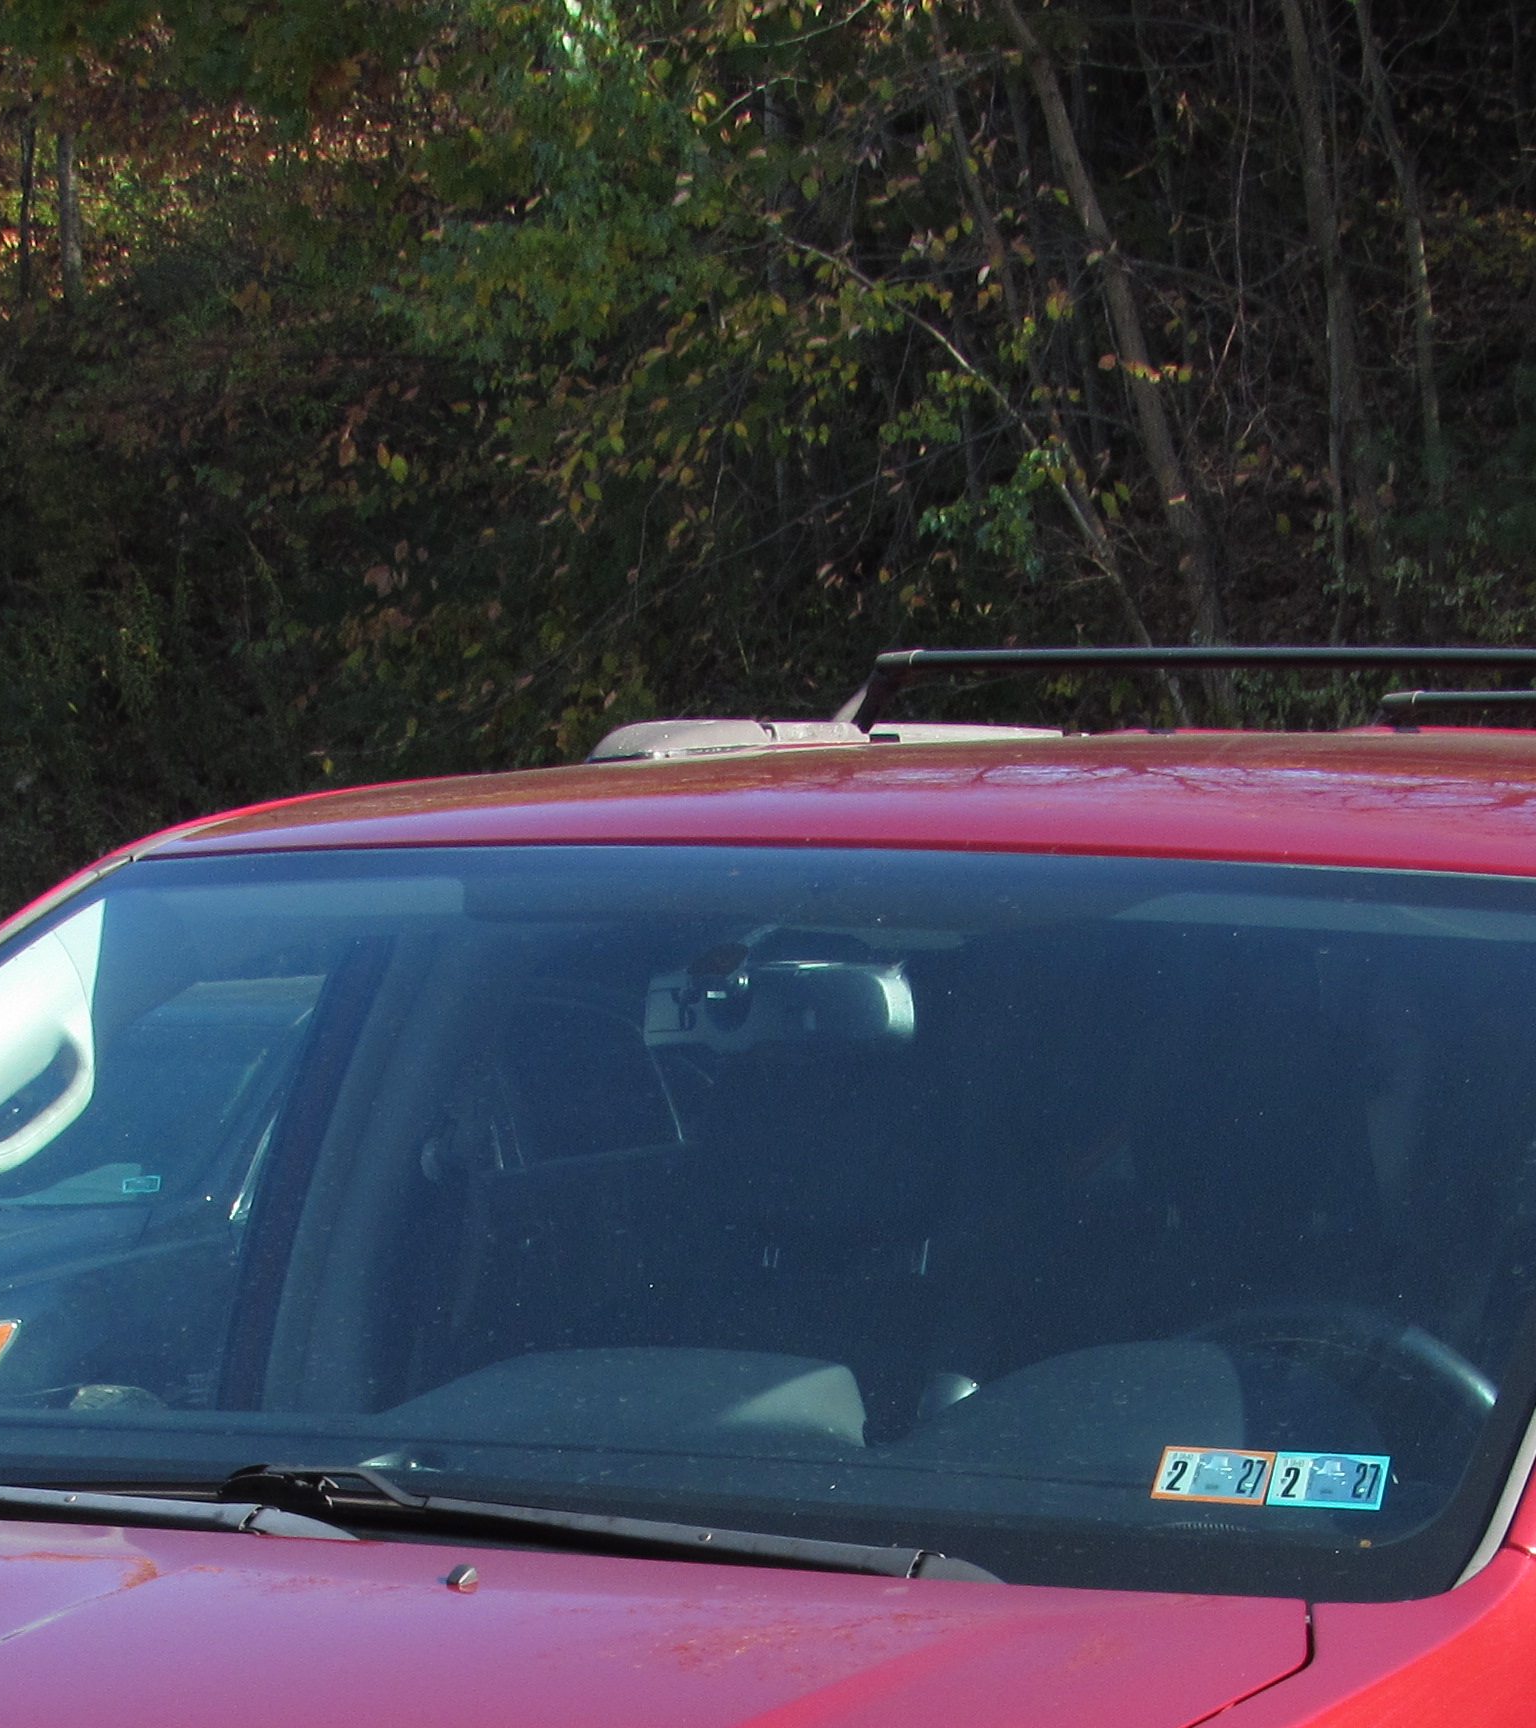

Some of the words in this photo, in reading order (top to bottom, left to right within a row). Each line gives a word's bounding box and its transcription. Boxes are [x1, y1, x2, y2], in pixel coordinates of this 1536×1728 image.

[1166, 1460, 1189, 1491] 2
[1235, 1459, 1267, 1497] 27
[1280, 1466, 1301, 1498] 2
[1351, 1463, 1381, 1500] 27
